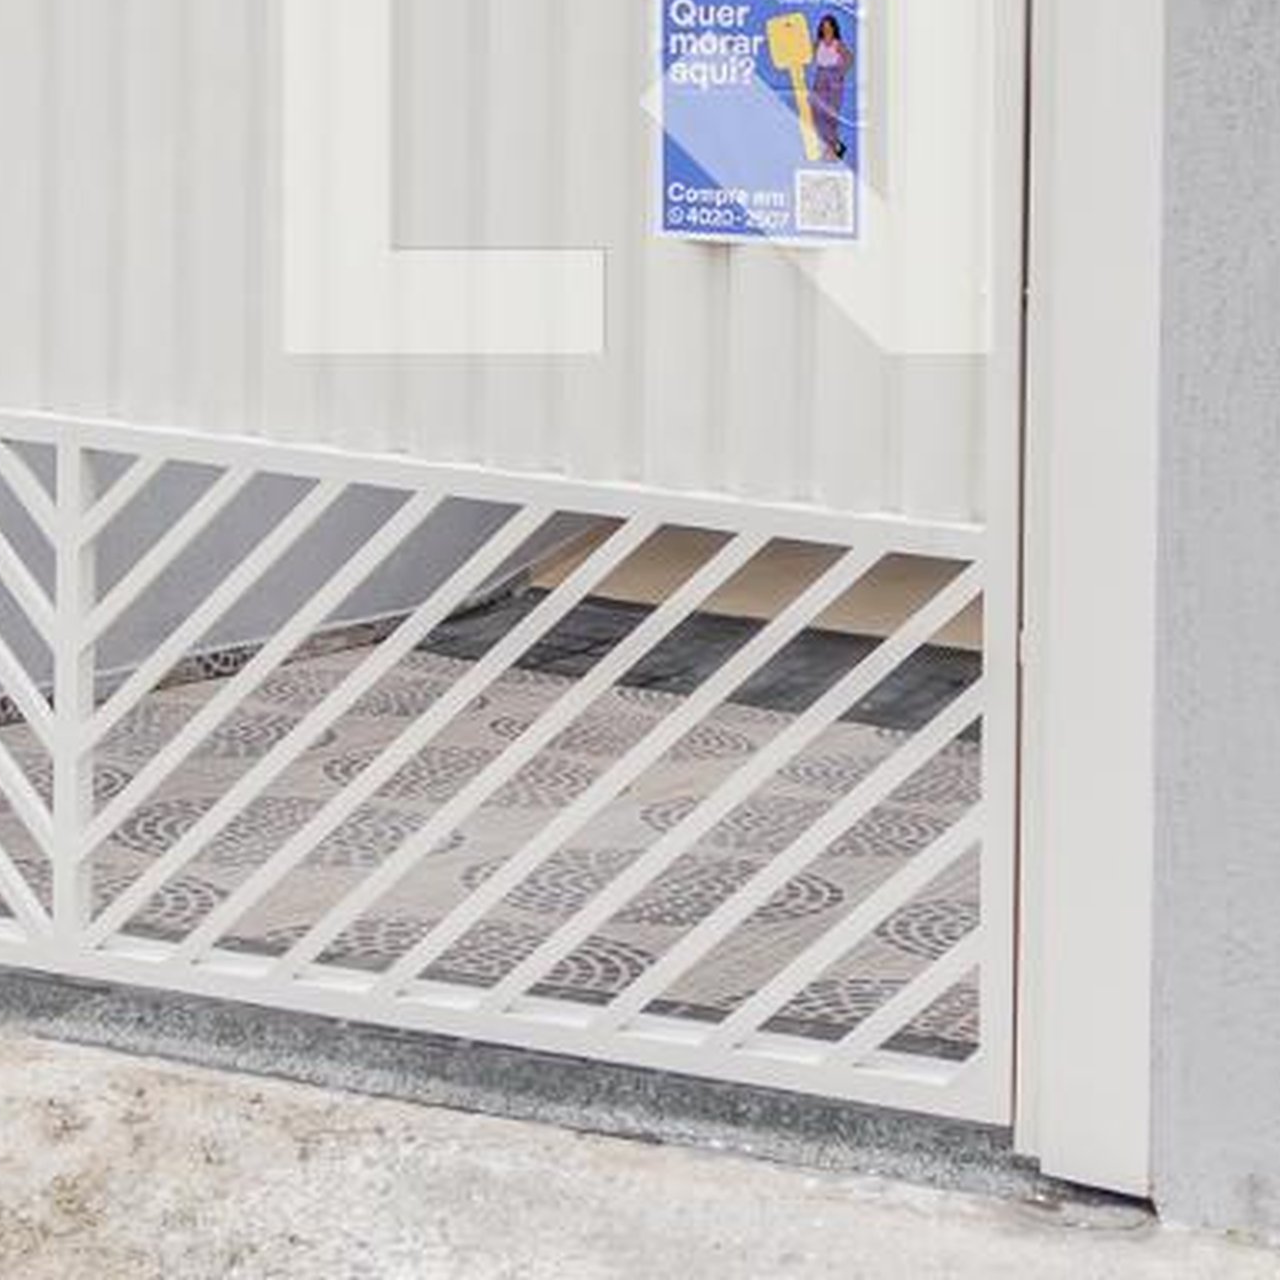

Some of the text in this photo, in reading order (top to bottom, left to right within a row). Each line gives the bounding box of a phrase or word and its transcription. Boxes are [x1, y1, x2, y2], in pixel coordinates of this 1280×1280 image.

[669, 31, 764, 56] morar
[669, 56, 755, 89] aqui?
[667, 182, 749, 207] Compre
